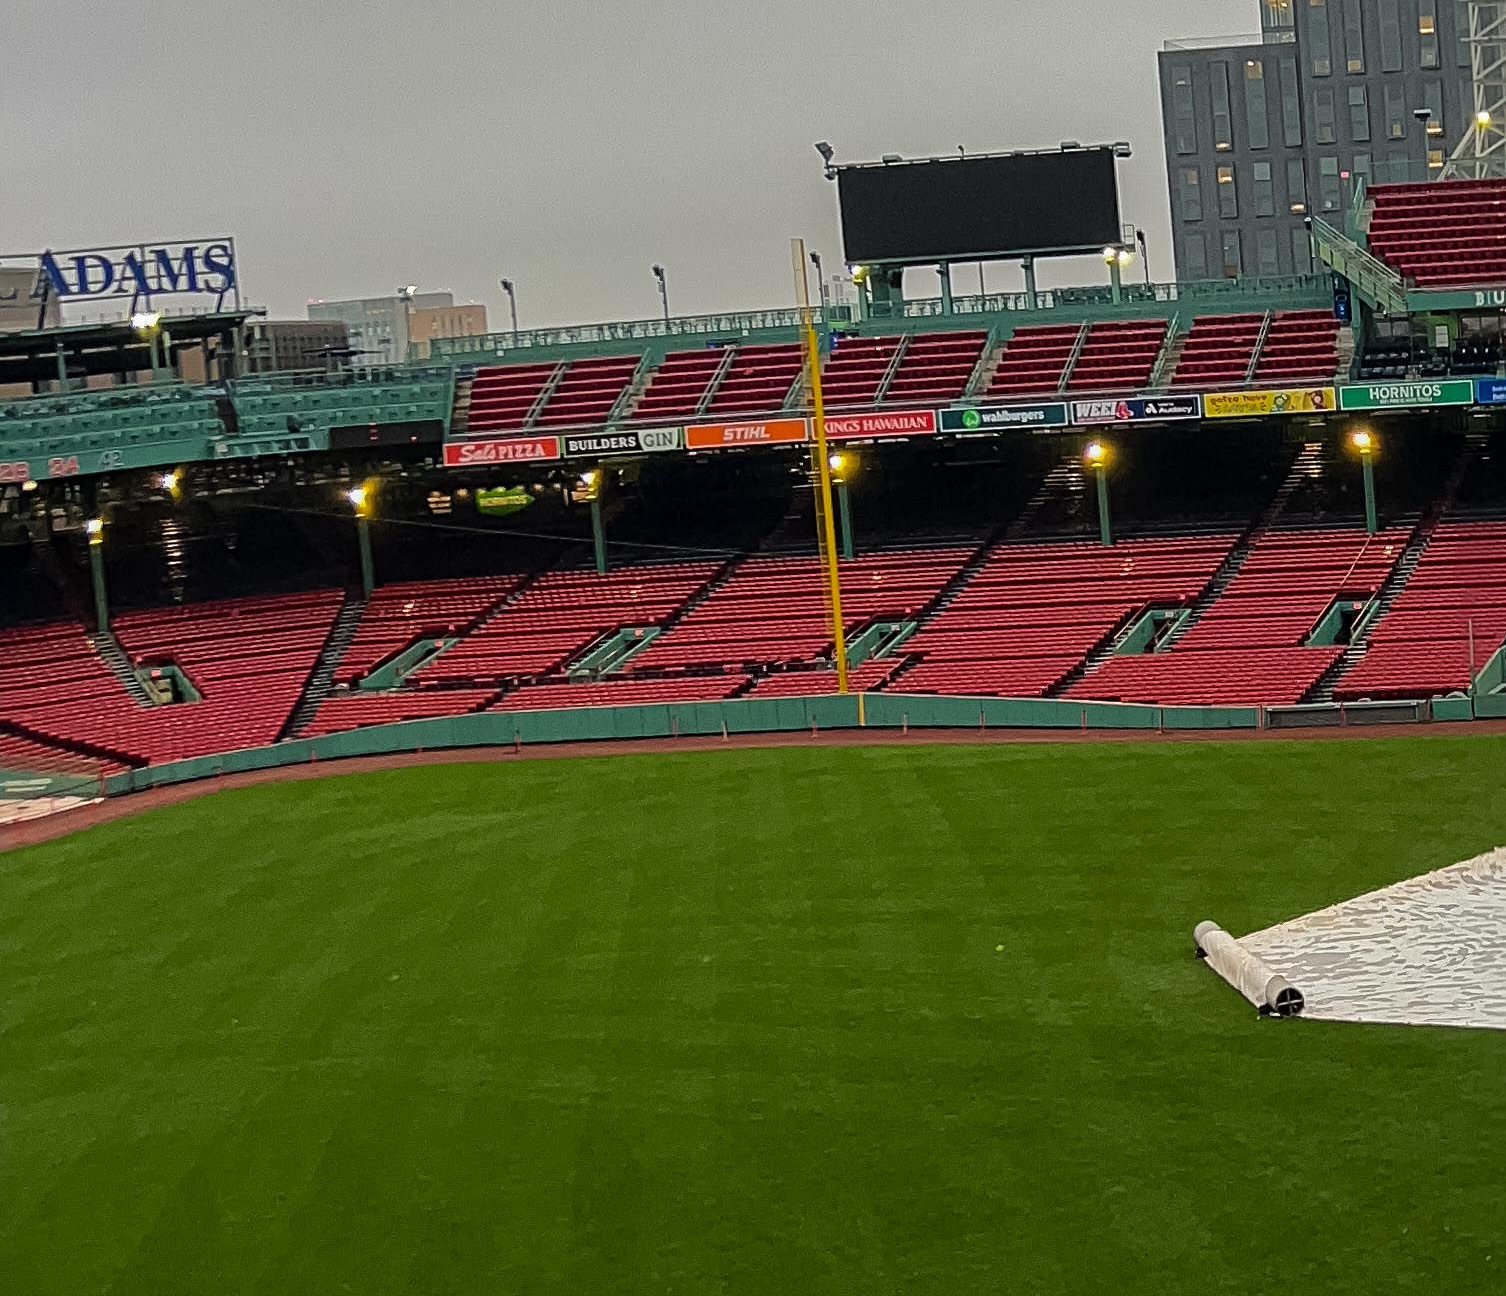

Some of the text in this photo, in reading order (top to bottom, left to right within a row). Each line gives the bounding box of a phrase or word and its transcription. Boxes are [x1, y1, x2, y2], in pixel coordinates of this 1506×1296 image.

[32, 244, 236, 296] ADAMS
[1369, 384, 1442, 400] HORNITOS
[982, 407, 1045, 424] wahlburgers
[1158, 405, 1193, 415] Audacy
[862, 415, 928, 432] HAWAIIAN
[568, 431, 674, 451] BUILDERS GIN
[722, 425, 771, 441] STIHL
[499, 443, 546, 460] PIZZA
